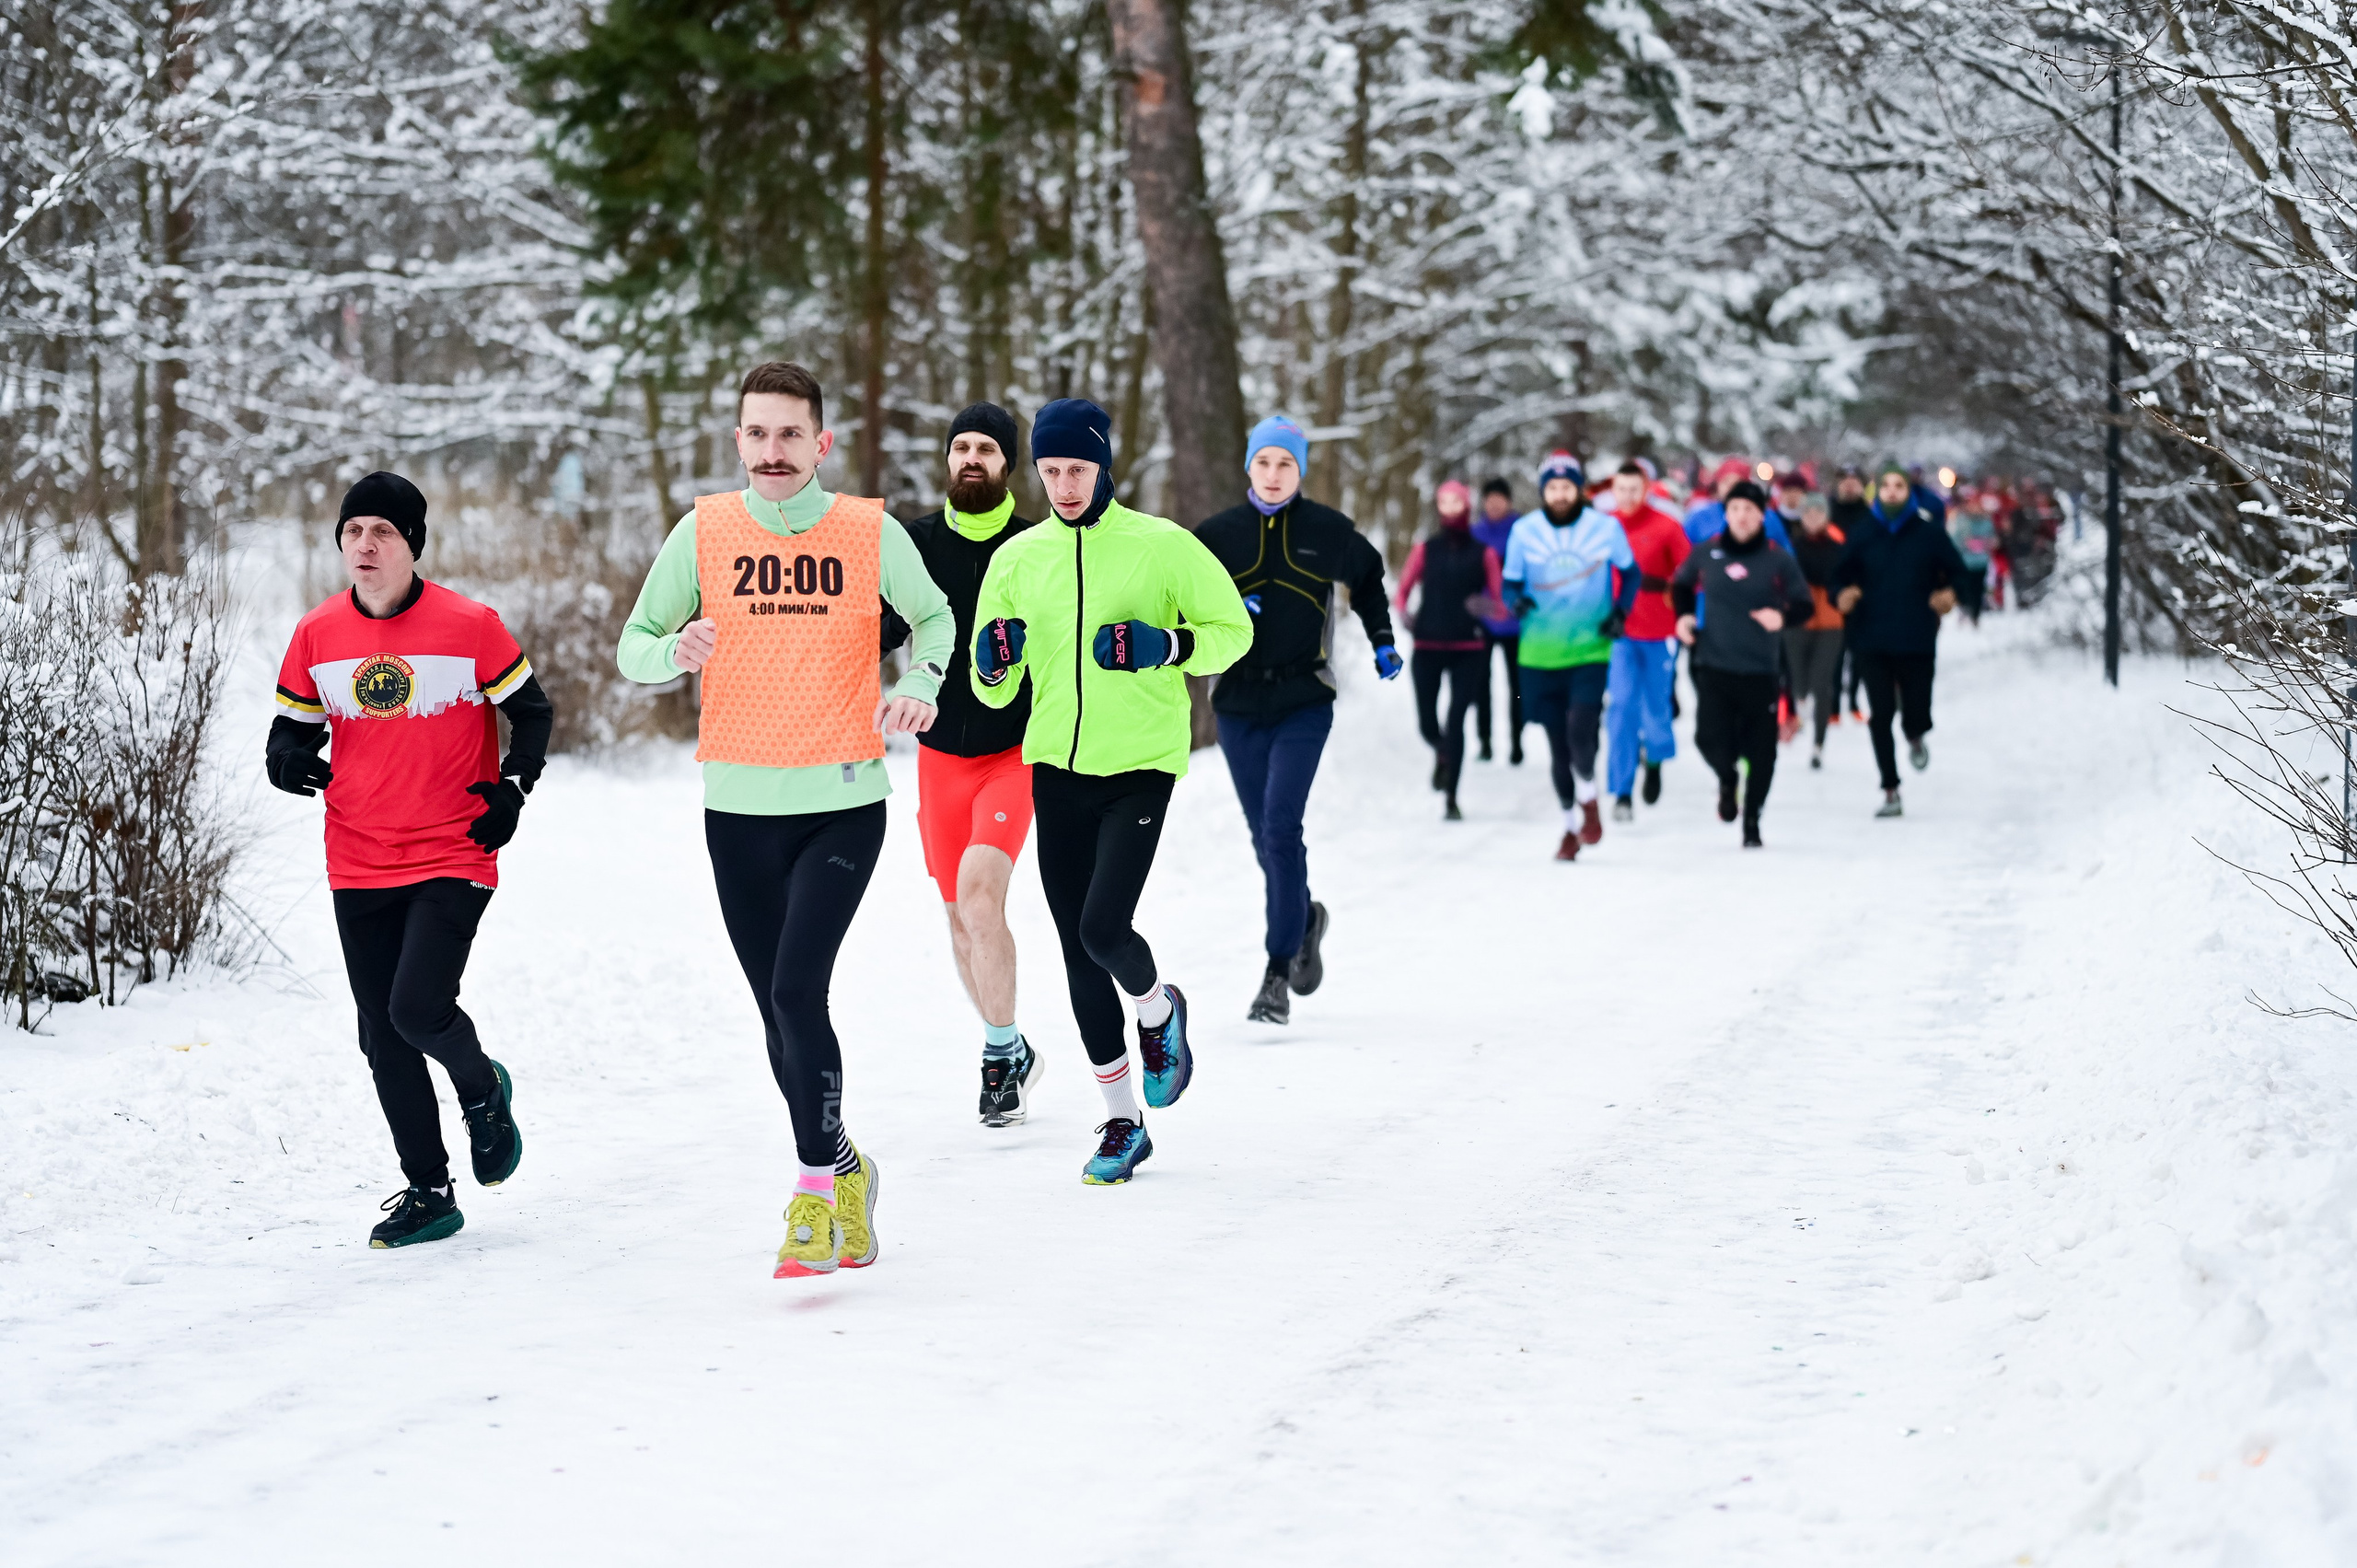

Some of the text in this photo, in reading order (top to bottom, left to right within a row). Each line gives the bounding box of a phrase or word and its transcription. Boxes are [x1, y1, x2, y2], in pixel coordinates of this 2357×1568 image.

[733, 554, 843, 597] 20:00
[749, 602, 775, 616] 4:00
[354, 655, 412, 679] SPARTAK MOSCOW
[365, 705, 404, 718] SUPPORTERS
[828, 855, 855, 871] FILA
[820, 1070, 841, 1133] FILA
